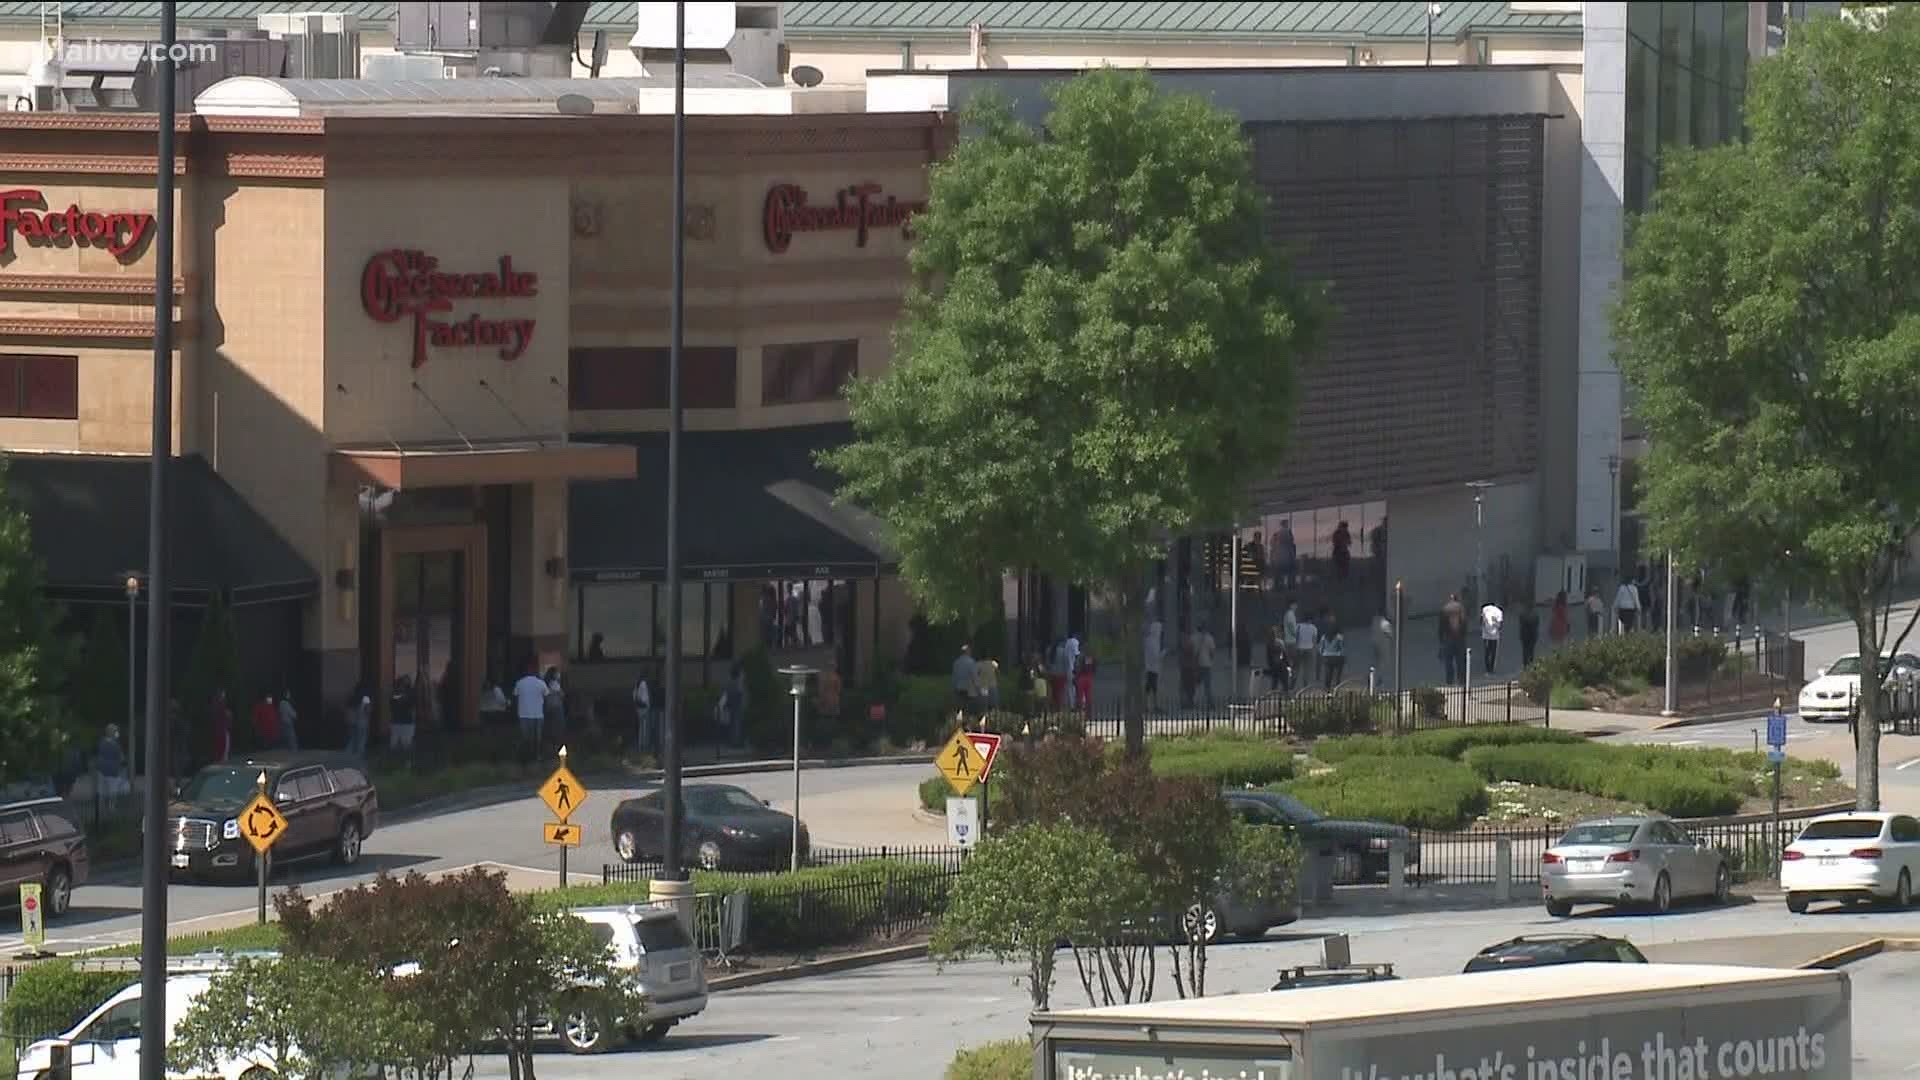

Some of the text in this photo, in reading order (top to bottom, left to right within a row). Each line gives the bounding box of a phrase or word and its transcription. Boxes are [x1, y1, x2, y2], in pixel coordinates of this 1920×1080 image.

[0, 189, 153, 257] Factory
[361, 250, 537, 323] Cheesecake
[398, 299, 537, 369] Factory
[1527, 1038, 1633, 1080] inside
[1641, 1032, 1709, 1080] that
[1717, 1026, 1826, 1079] counts
